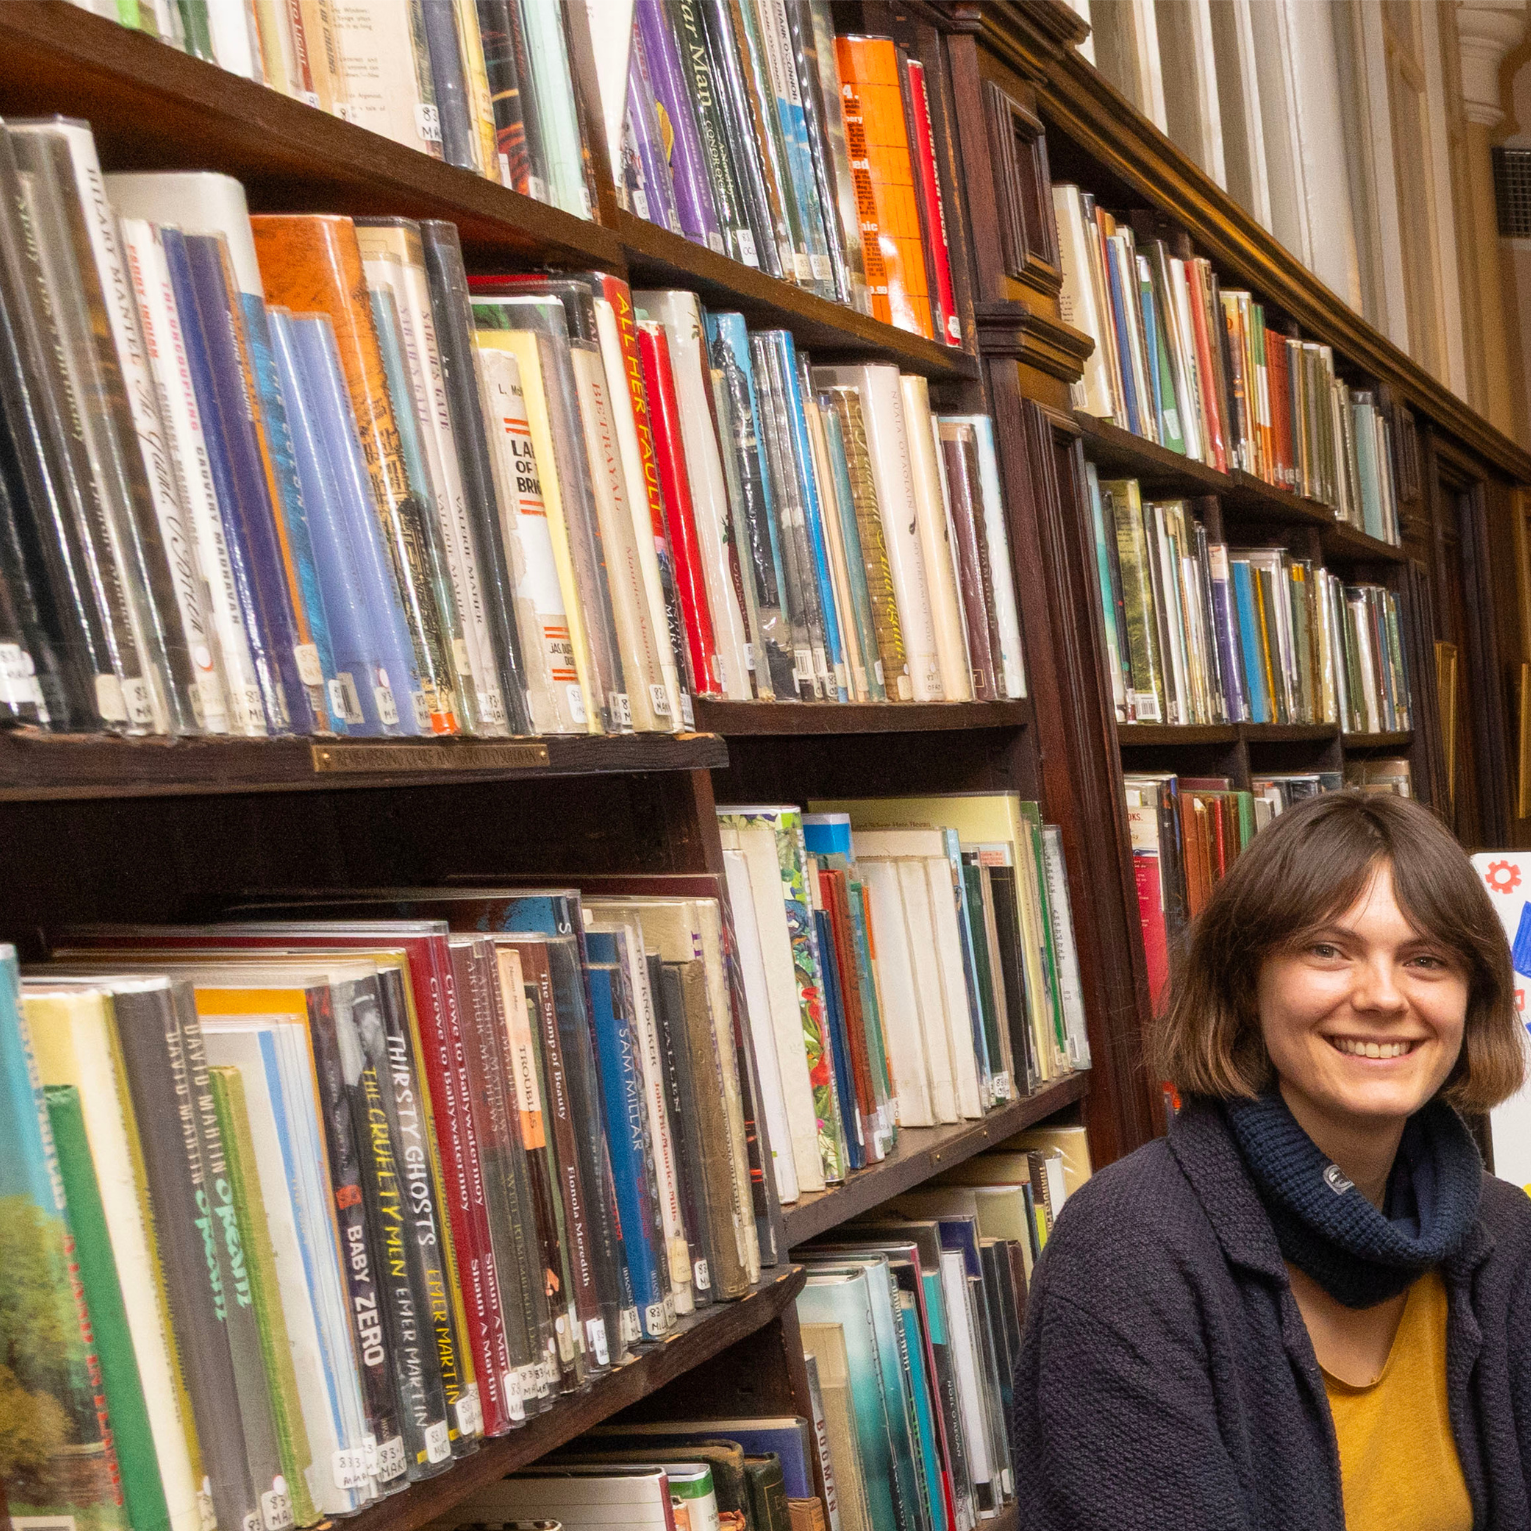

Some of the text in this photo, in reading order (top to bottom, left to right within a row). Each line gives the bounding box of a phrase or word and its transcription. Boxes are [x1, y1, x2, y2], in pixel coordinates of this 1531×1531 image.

[688, 45, 712, 107] Man
[591, 383, 621, 512] BETRAYAL
[628, 348, 663, 512] HER FAULT
[382, 1032, 436, 1246] THIRSTY GHOSTS
[624, 1079, 643, 1153] MILLAR
[347, 1224, 384, 1368] BABY ZERO
[434, 1324, 458, 1406] MARTIN
